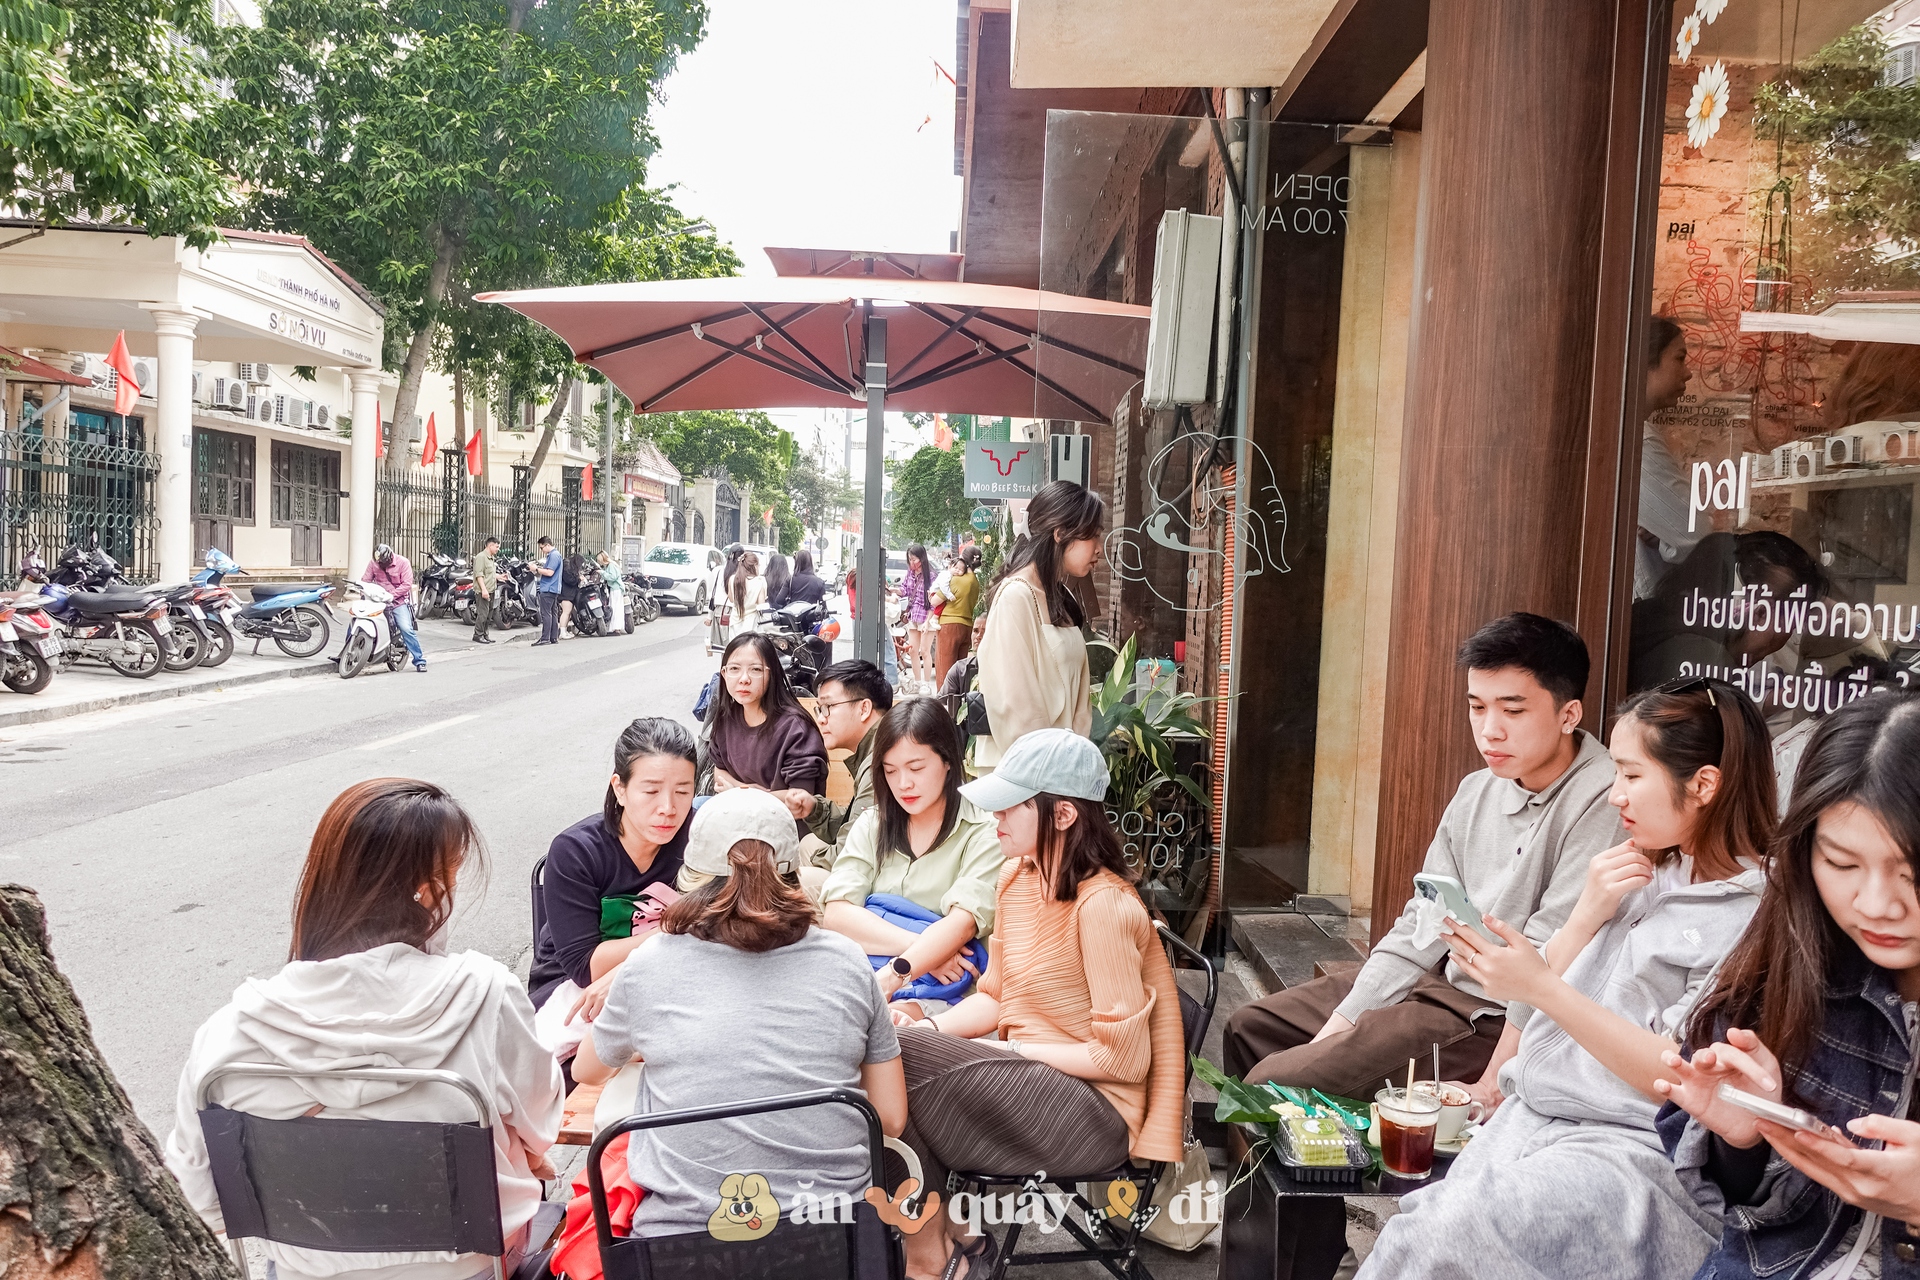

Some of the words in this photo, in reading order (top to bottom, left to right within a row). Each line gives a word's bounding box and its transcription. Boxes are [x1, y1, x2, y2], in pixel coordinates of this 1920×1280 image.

[1669, 219, 1695, 237] pai
[279, 278, 303, 295] THÀNH
[304, 288, 318, 302] PHỐ
[319, 294, 329, 306] HÀ
[269, 311, 287, 333] SỞ
[289, 318, 309, 343] NỘI
[311, 327, 326, 349] VỤ
[1679, 395, 1697, 404] 095
[1696, 407, 1710, 415] TO
[1713, 407, 1730, 416] PAI
[1652, 416, 1676, 426] KMS
[1701, 418, 1747, 429] CURVES
[1682, 583, 1920, 644] ปายมีไว้เพื่อความ
